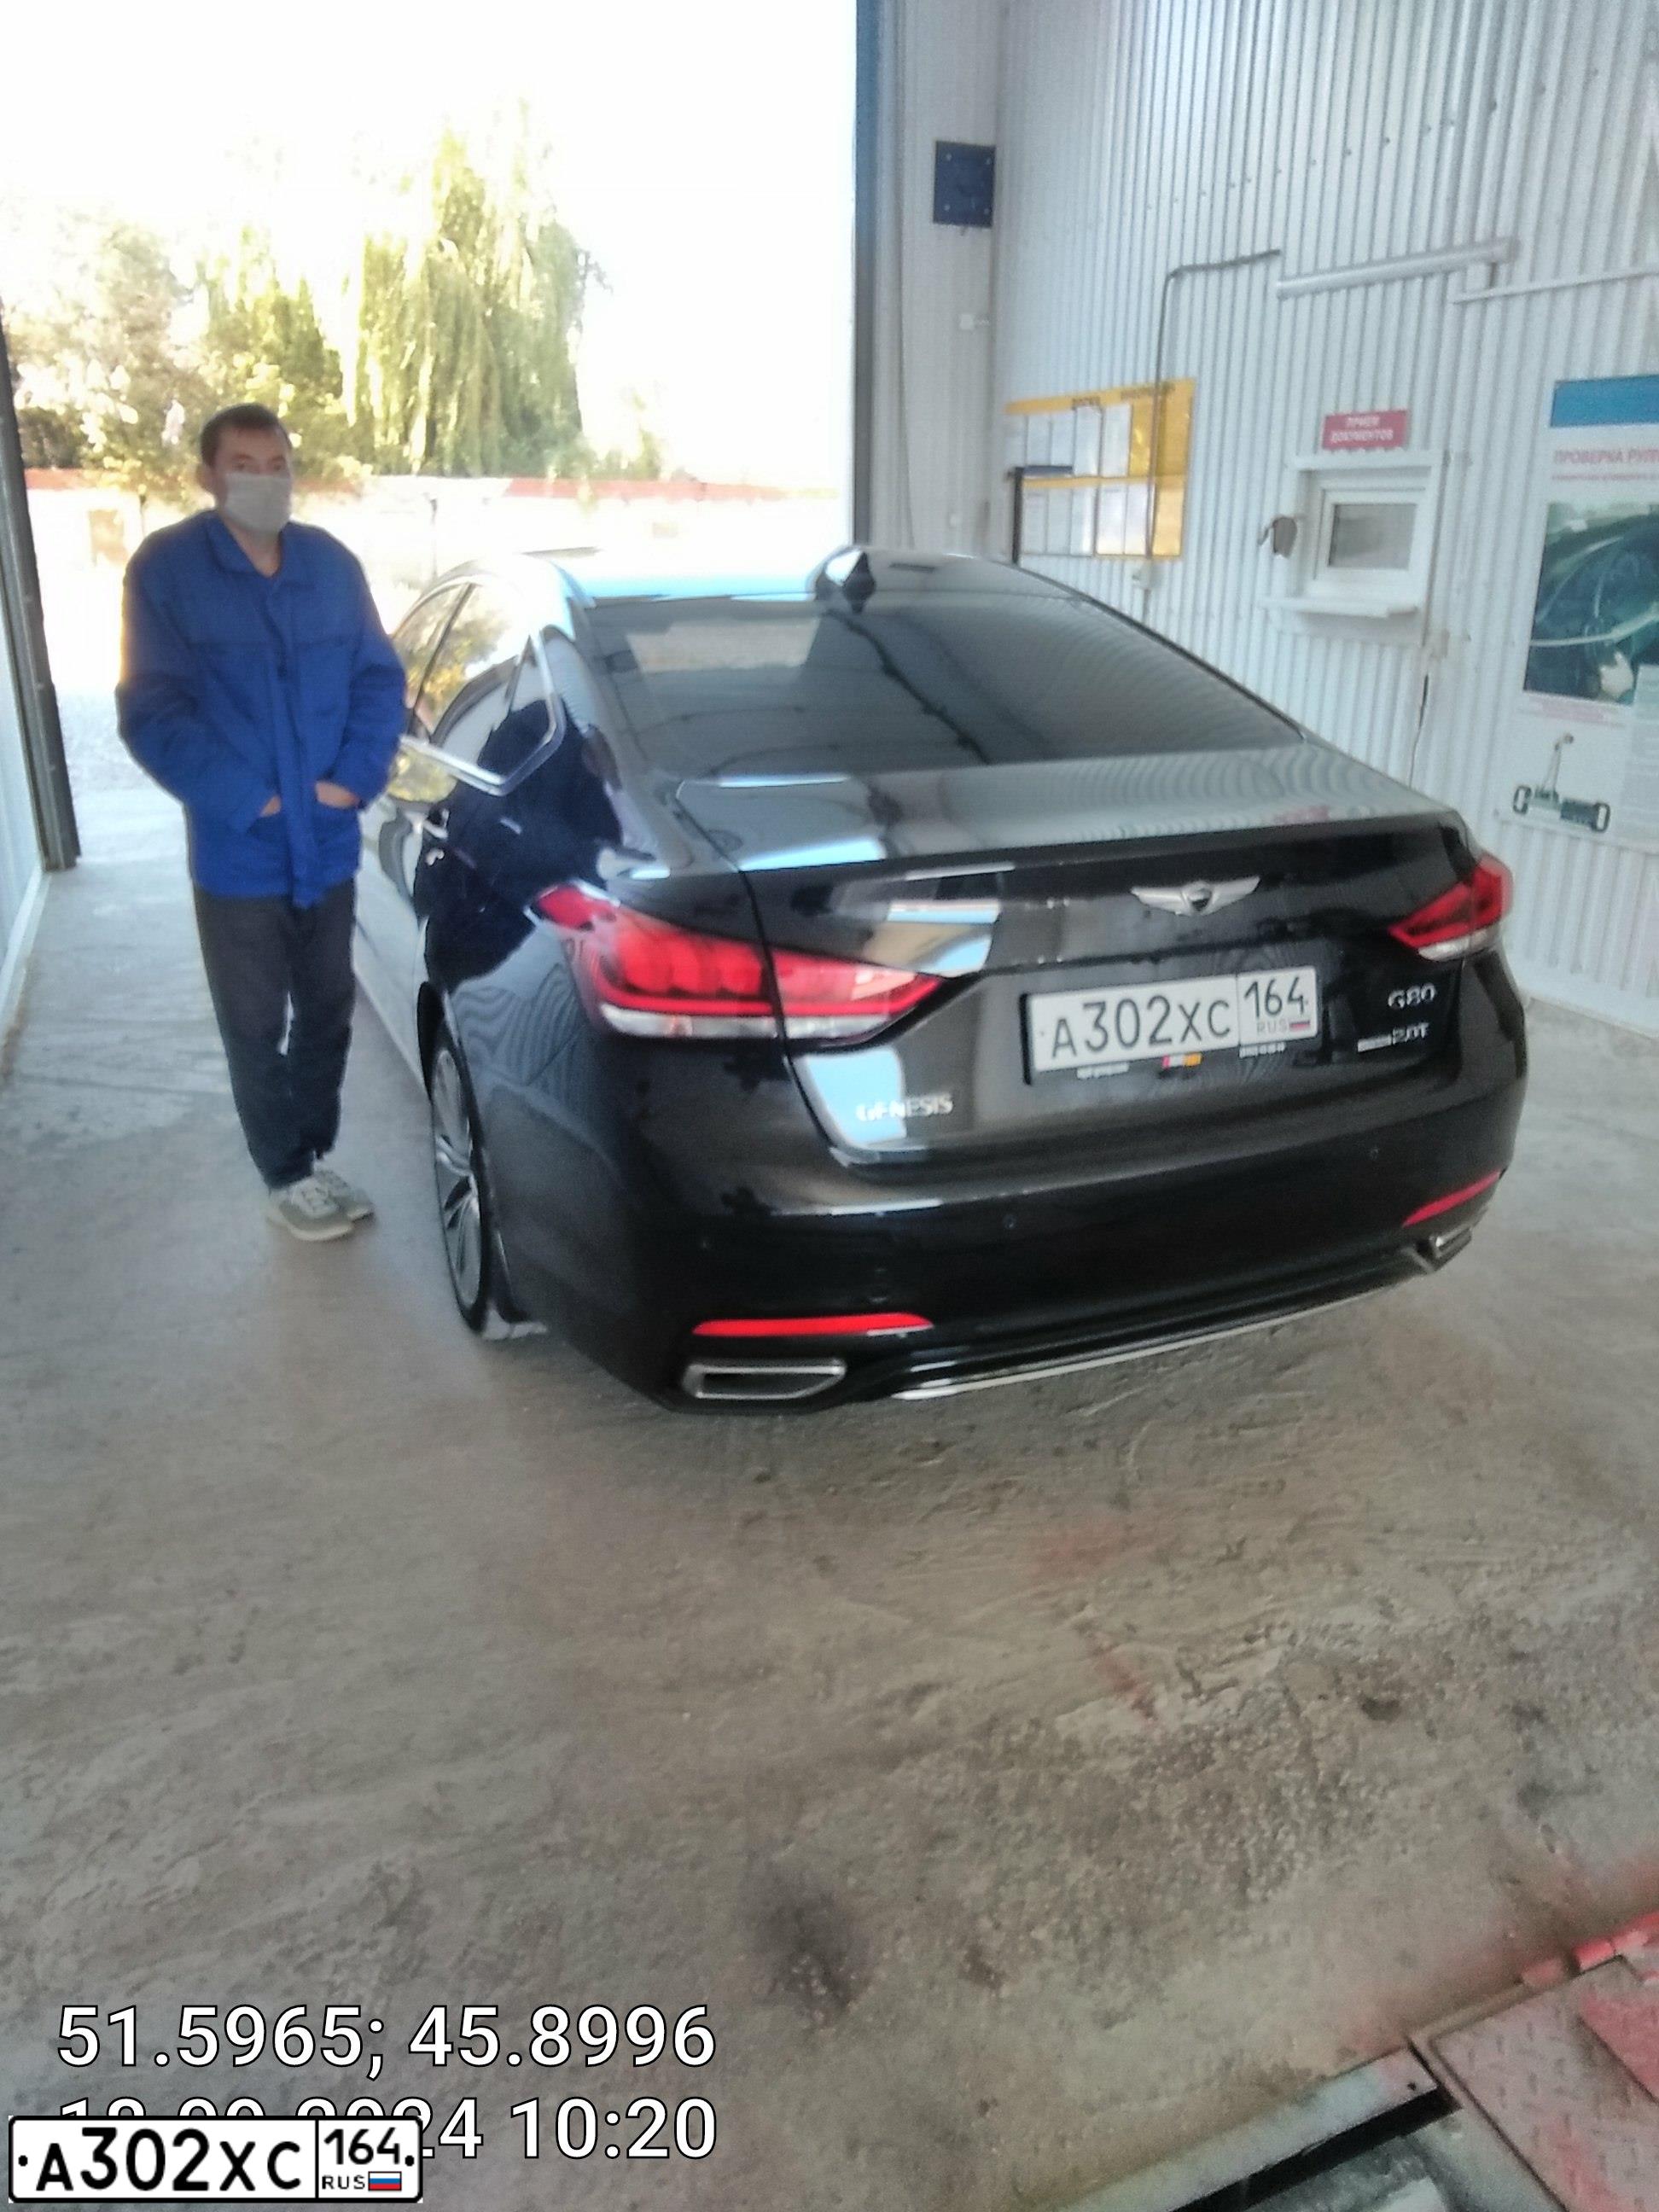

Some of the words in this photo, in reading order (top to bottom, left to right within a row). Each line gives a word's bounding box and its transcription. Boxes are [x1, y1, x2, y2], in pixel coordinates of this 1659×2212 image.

[1388, 982, 1437, 1009] G80
[1051, 995, 1231, 1059] А302ХС
[1243, 976, 1305, 1018] 164
[1255, 1018, 1289, 1034] RUS
